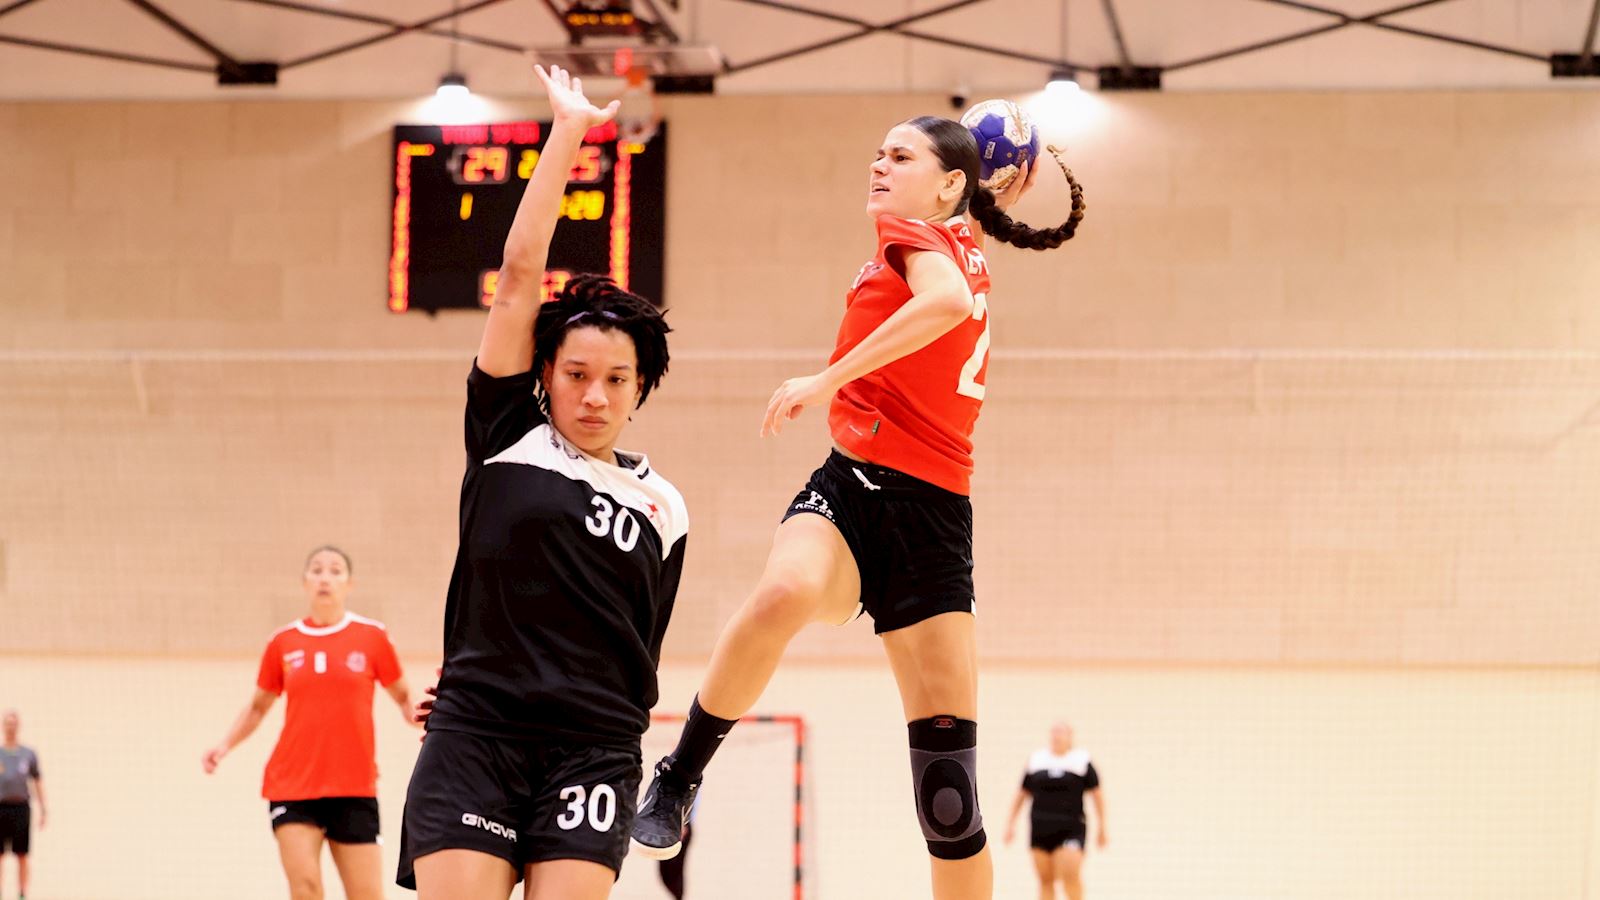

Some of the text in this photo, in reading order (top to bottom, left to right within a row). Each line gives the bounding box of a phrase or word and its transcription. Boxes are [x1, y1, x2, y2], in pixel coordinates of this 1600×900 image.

[463, 147, 508, 182] 29
[585, 494, 641, 553] 30
[461, 812, 517, 843] GIVOVA
[557, 783, 616, 833] 30
